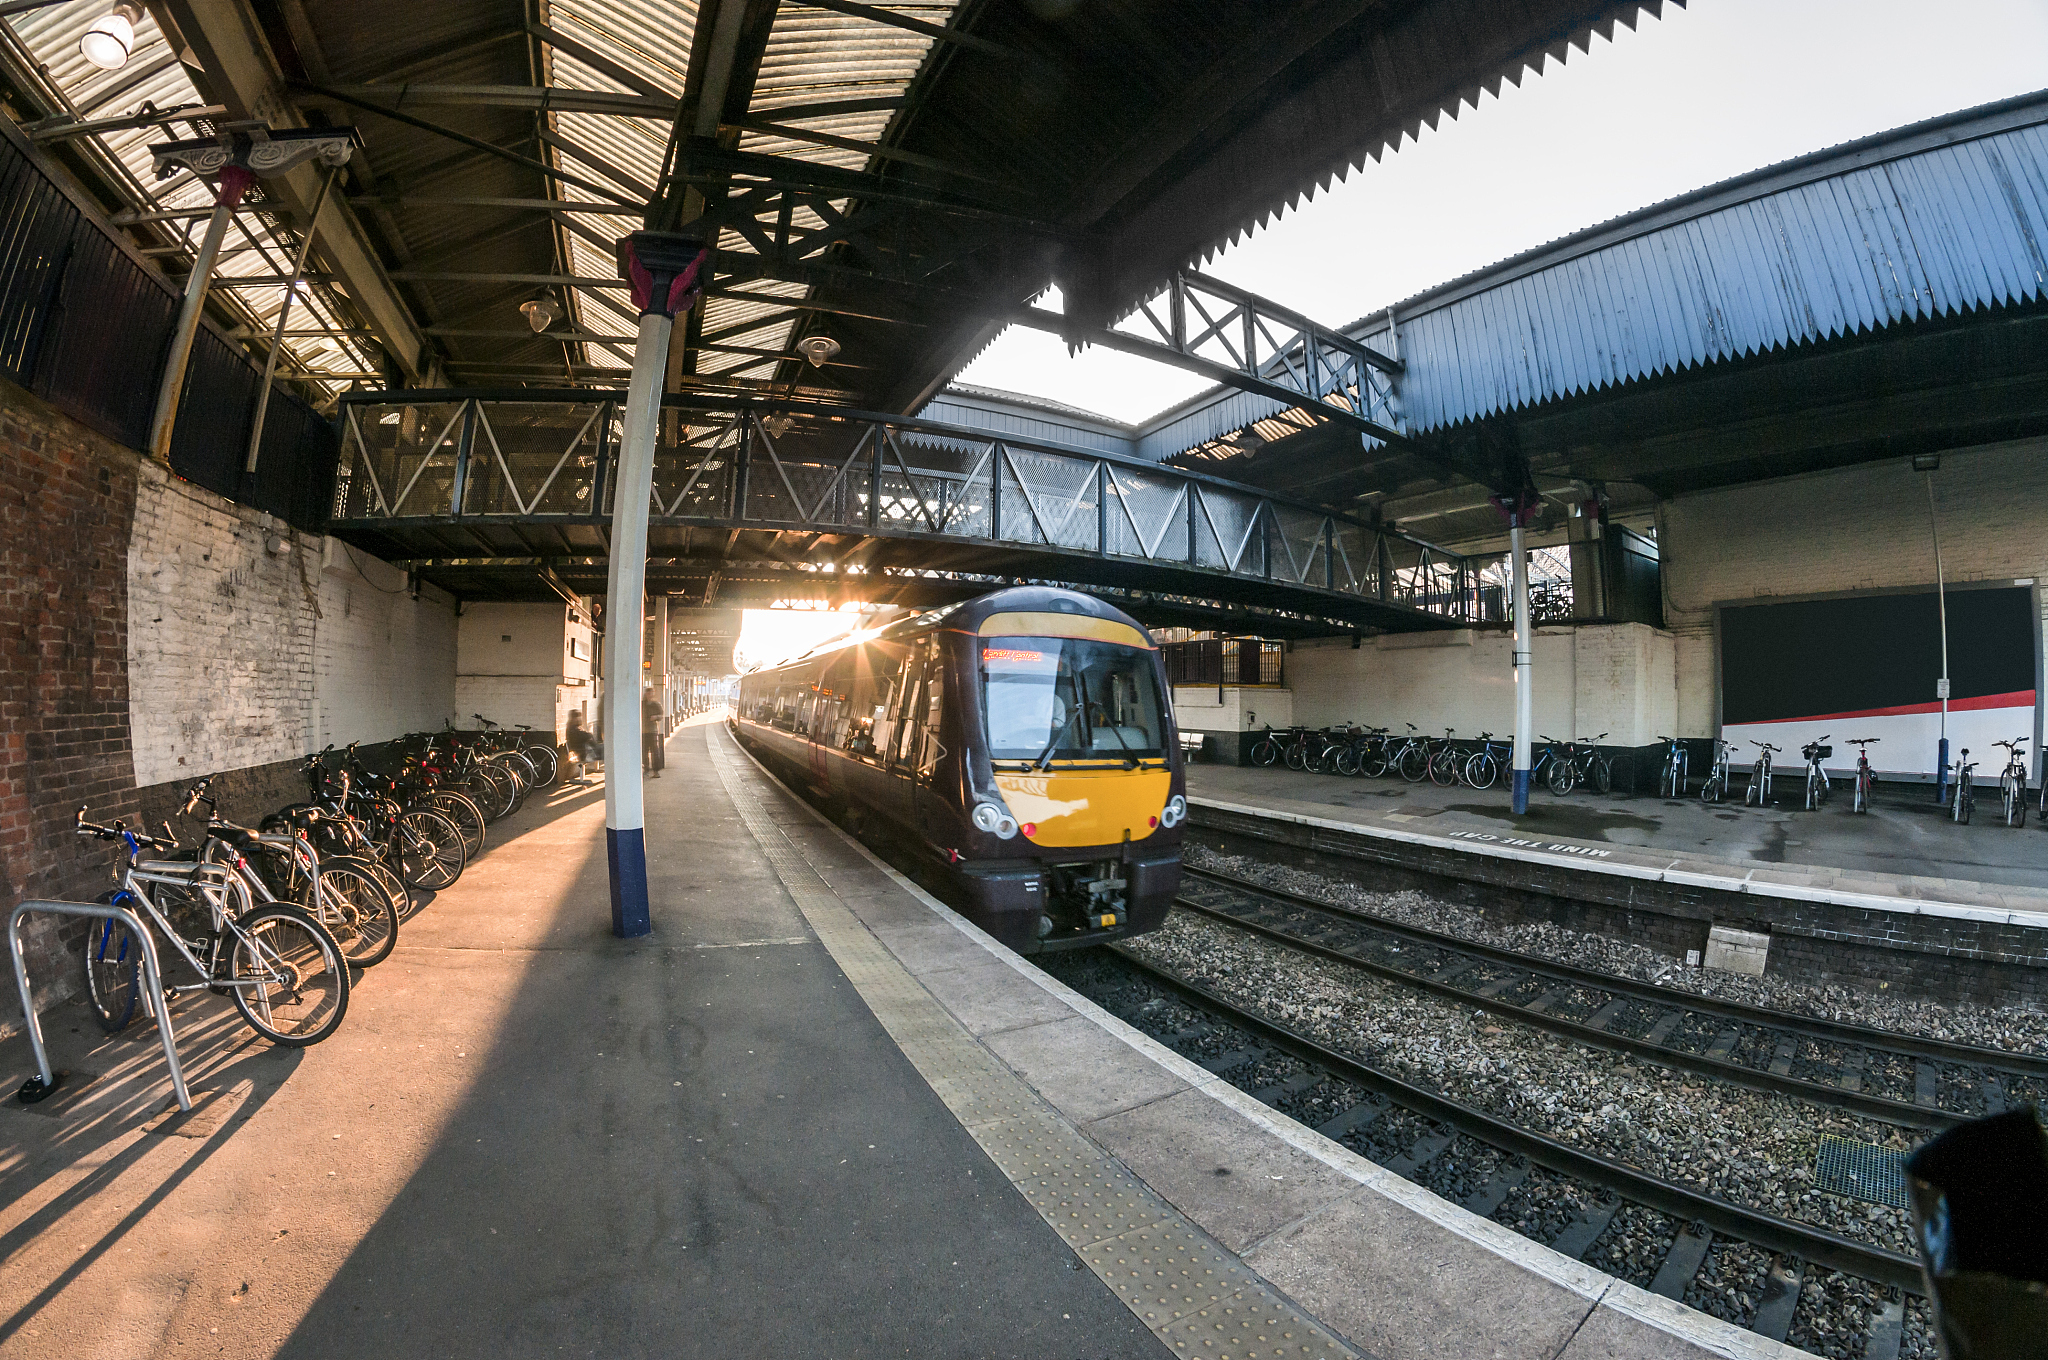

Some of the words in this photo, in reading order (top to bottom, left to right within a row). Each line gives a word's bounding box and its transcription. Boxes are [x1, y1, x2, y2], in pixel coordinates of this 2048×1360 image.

[1449, 831, 1499, 841] GAP
[1500, 837, 1542, 848] THE
[1548, 844, 1612, 857] MIND
